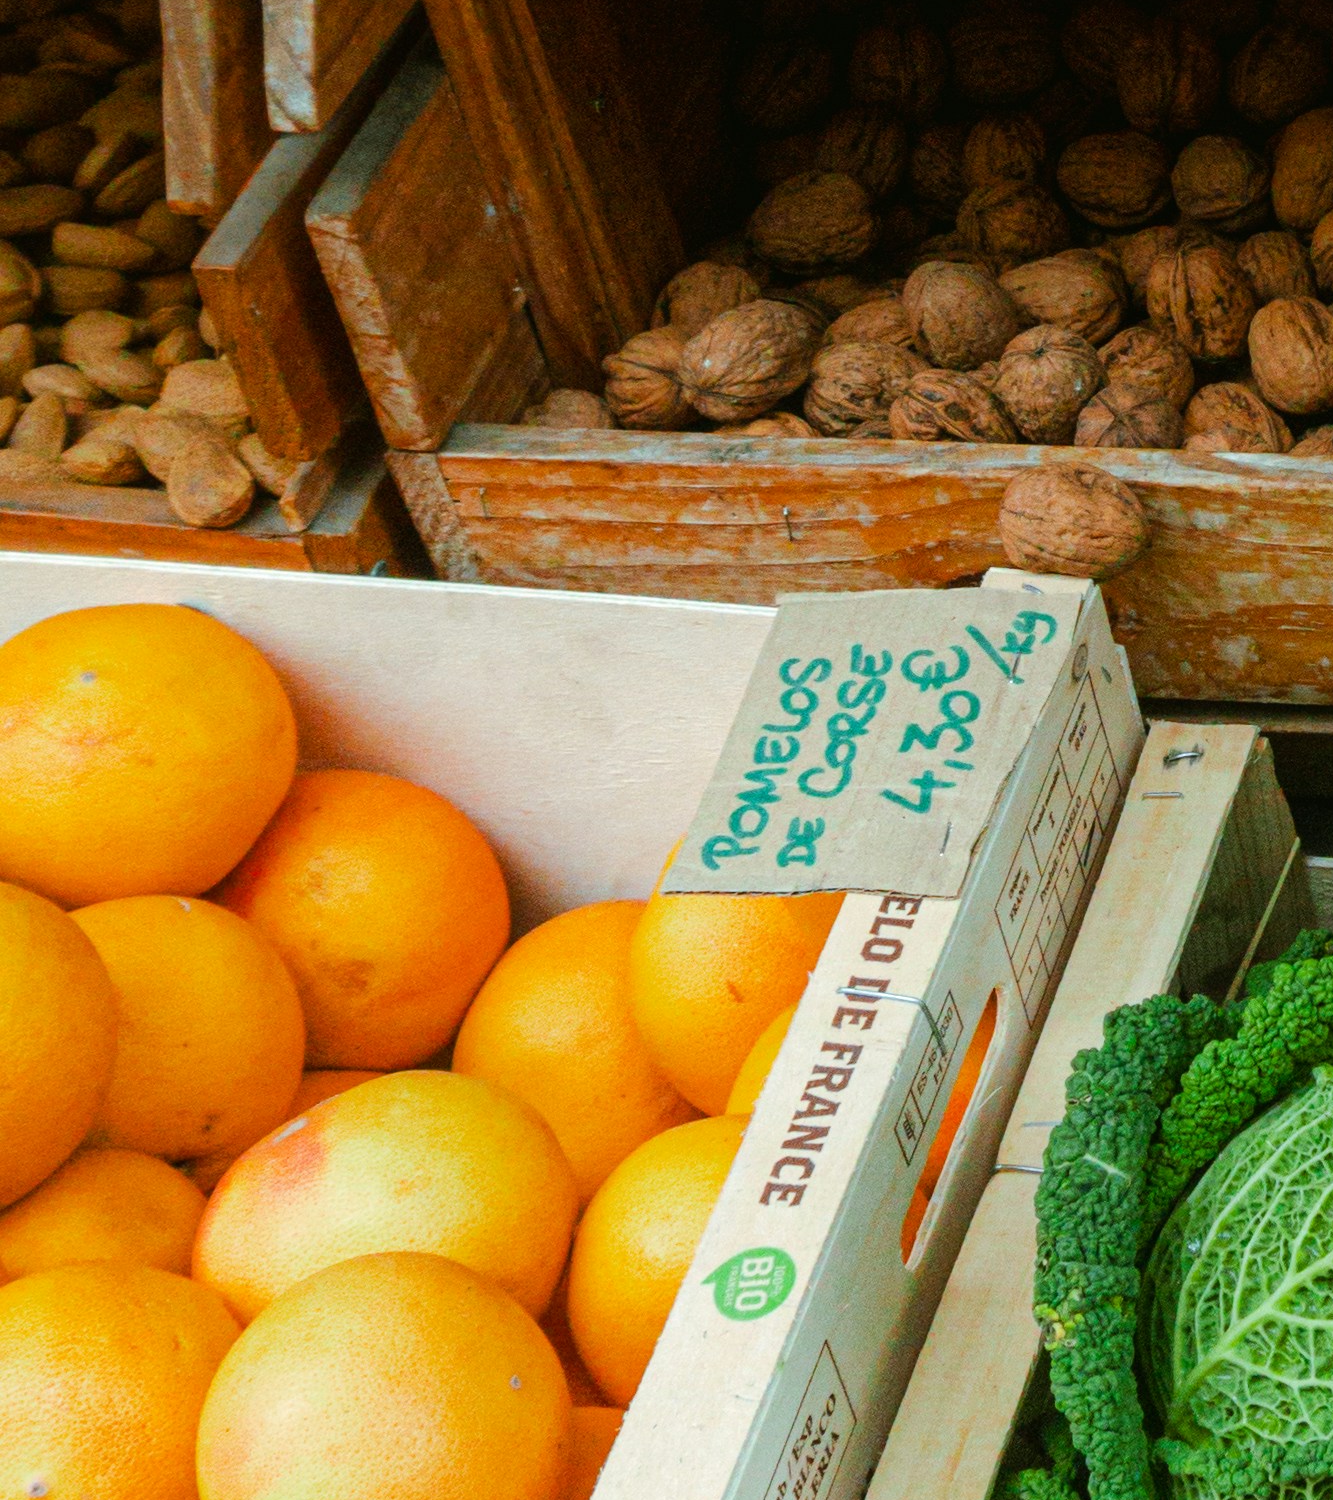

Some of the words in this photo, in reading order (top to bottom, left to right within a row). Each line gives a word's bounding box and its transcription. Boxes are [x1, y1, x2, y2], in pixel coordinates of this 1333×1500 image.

[797, 644, 892, 799] CORSE
[701, 657, 832, 870] POMELOS
[777, 815, 825, 868] DE
[831, 975, 891, 1031] DE
[758, 1040, 864, 1209] FRANCE
[735, 1256, 775, 1311] BIO
[792, 1415, 813, 1463] Exp
[792, 1393, 836, 1500] BIANCO
